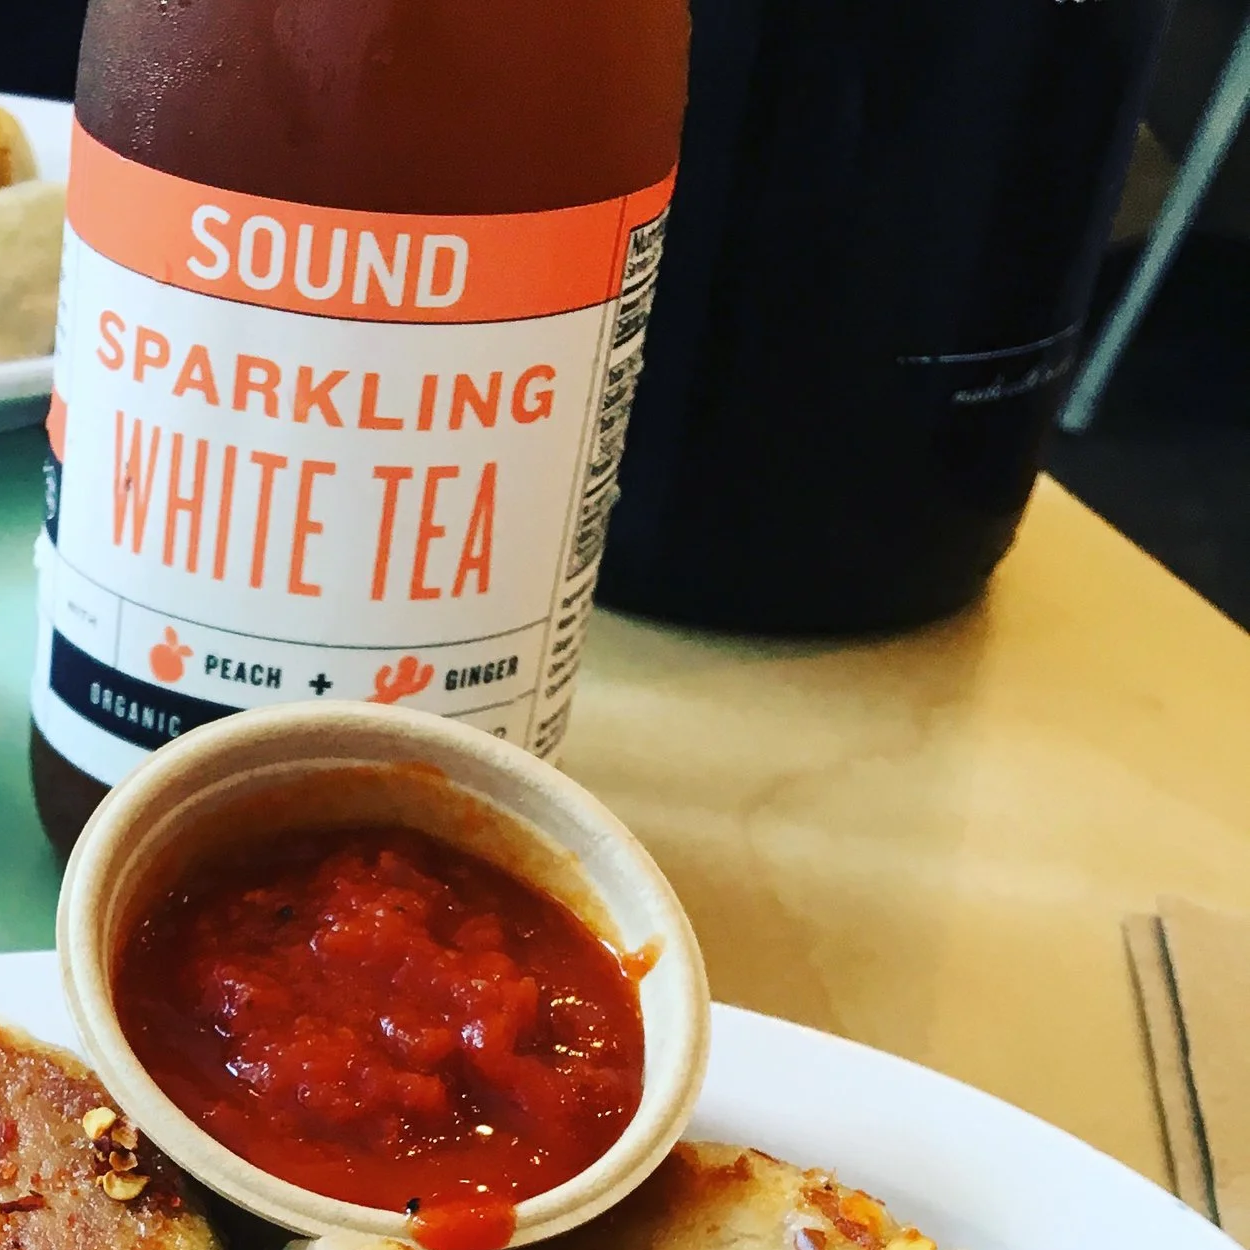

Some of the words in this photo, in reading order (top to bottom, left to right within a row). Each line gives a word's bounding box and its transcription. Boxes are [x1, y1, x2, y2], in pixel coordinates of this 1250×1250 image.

[186, 204, 469, 309] SOUND
[96, 310, 557, 431] SPARKLING
[112, 410, 337, 598] WHITE
[370, 462, 498, 602] TEA
[89, 681, 182, 738] ORGANIC
[204, 653, 282, 690] PEACH
[444, 655, 519, 691] GINGER
